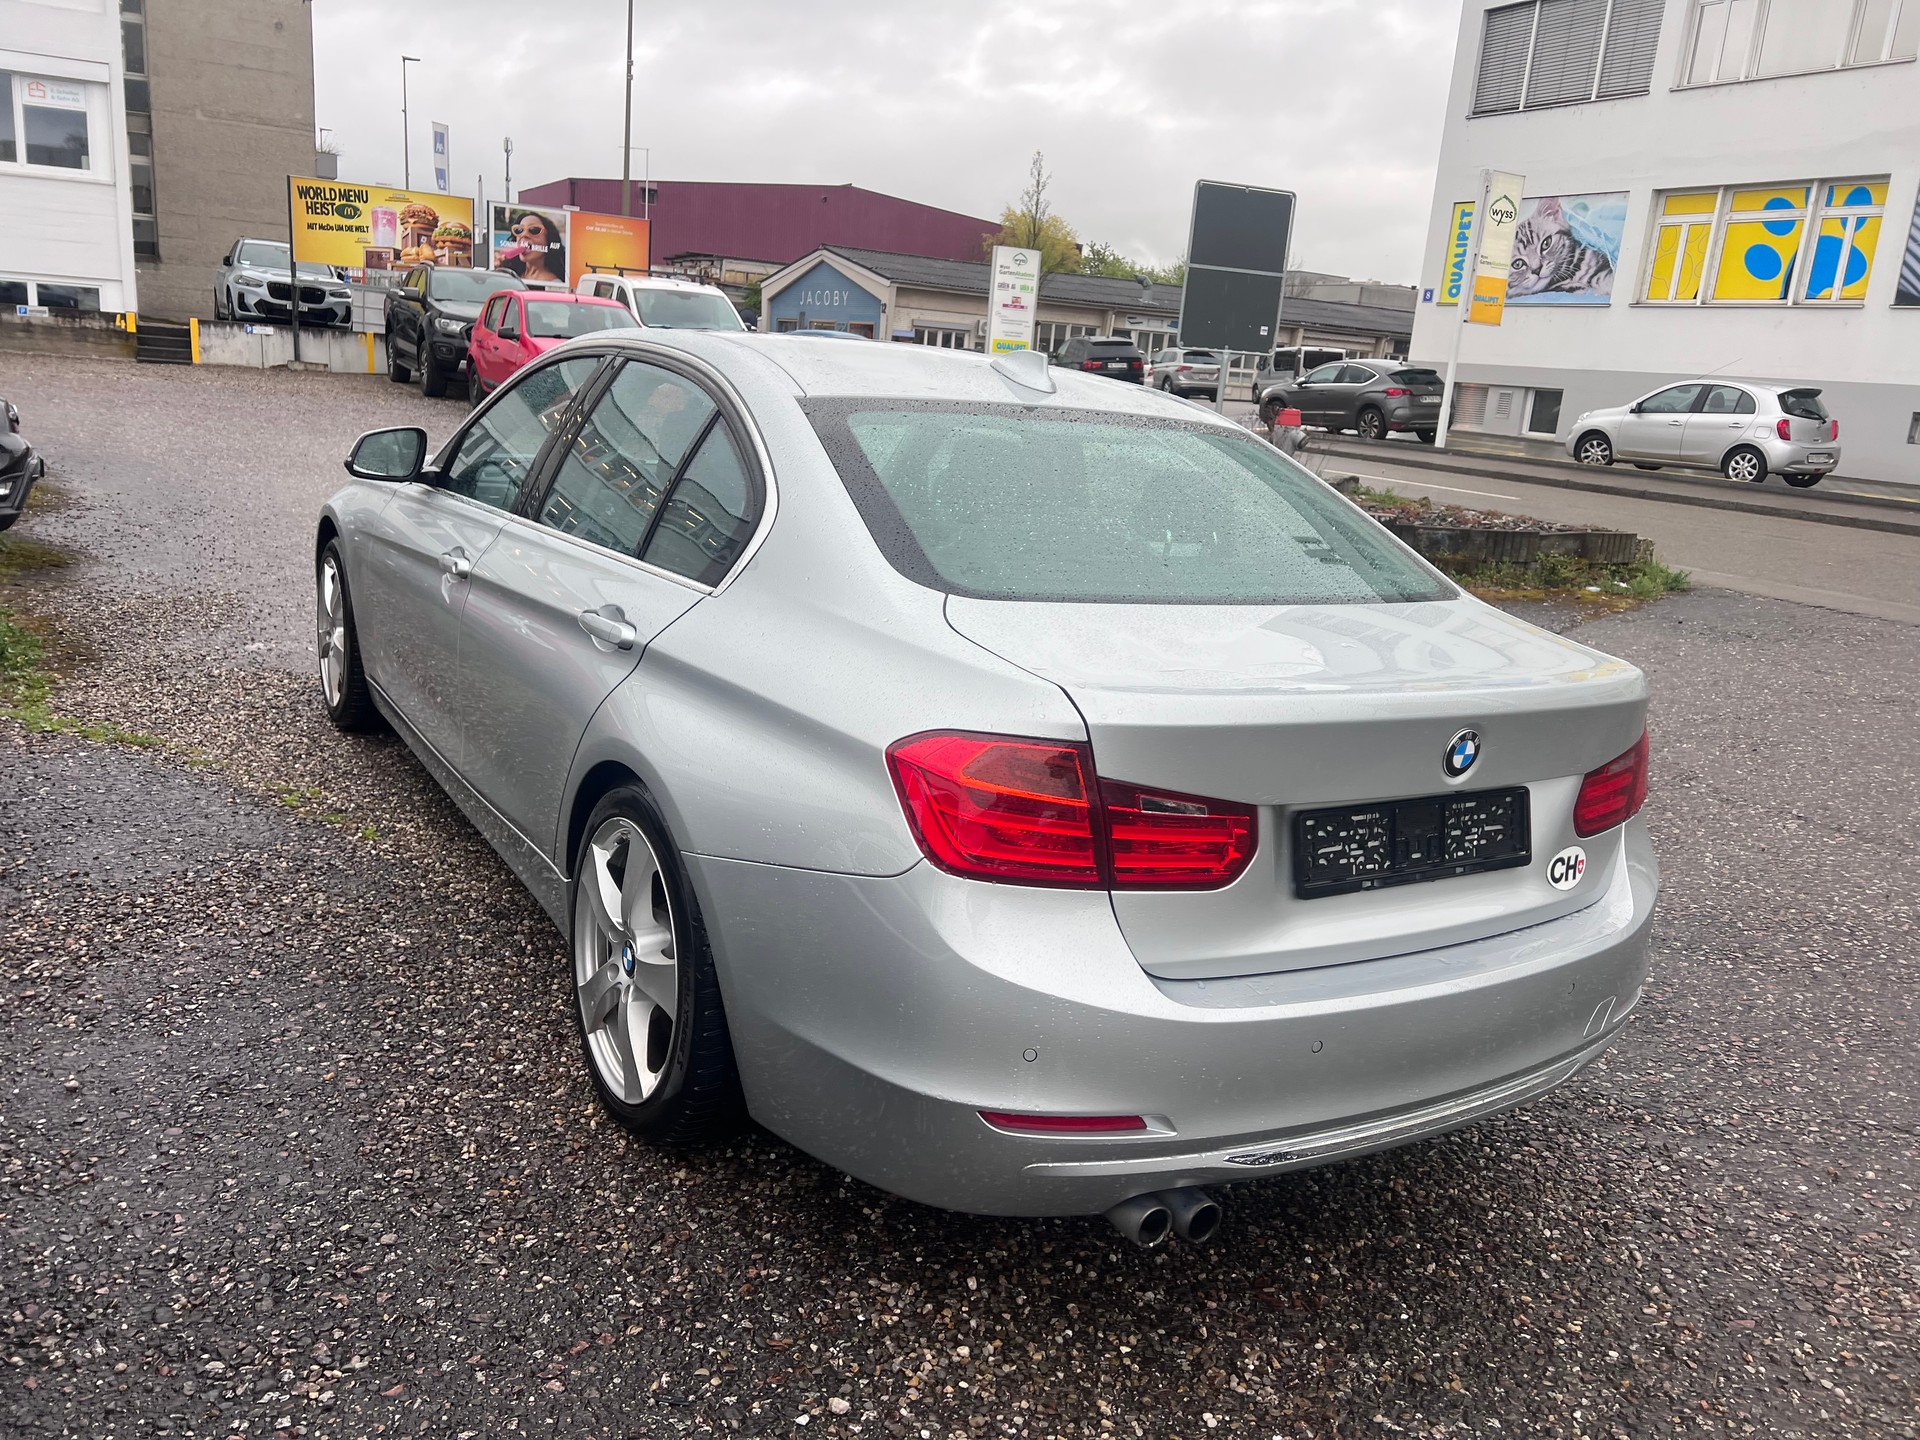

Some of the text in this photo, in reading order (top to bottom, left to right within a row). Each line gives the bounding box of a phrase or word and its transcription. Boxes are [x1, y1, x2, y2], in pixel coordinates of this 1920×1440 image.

[297, 185, 337, 202] WORLD
[338, 188, 369, 204] MENU
[305, 200, 336, 216] HEIST
[1491, 206, 1514, 227] wyss
[306, 222, 369, 234] MIT McDo UM DIE WELT
[549, 242, 561, 250] AUF
[1448, 208, 1473, 299] QUALIPET
[799, 290, 849, 306] JACOBY
[1473, 294, 1499, 304] QUALIPET
[996, 341, 1027, 351] QUALIPET
[1453, 731, 1481, 748] BMW
[1550, 853, 1580, 884] CH
